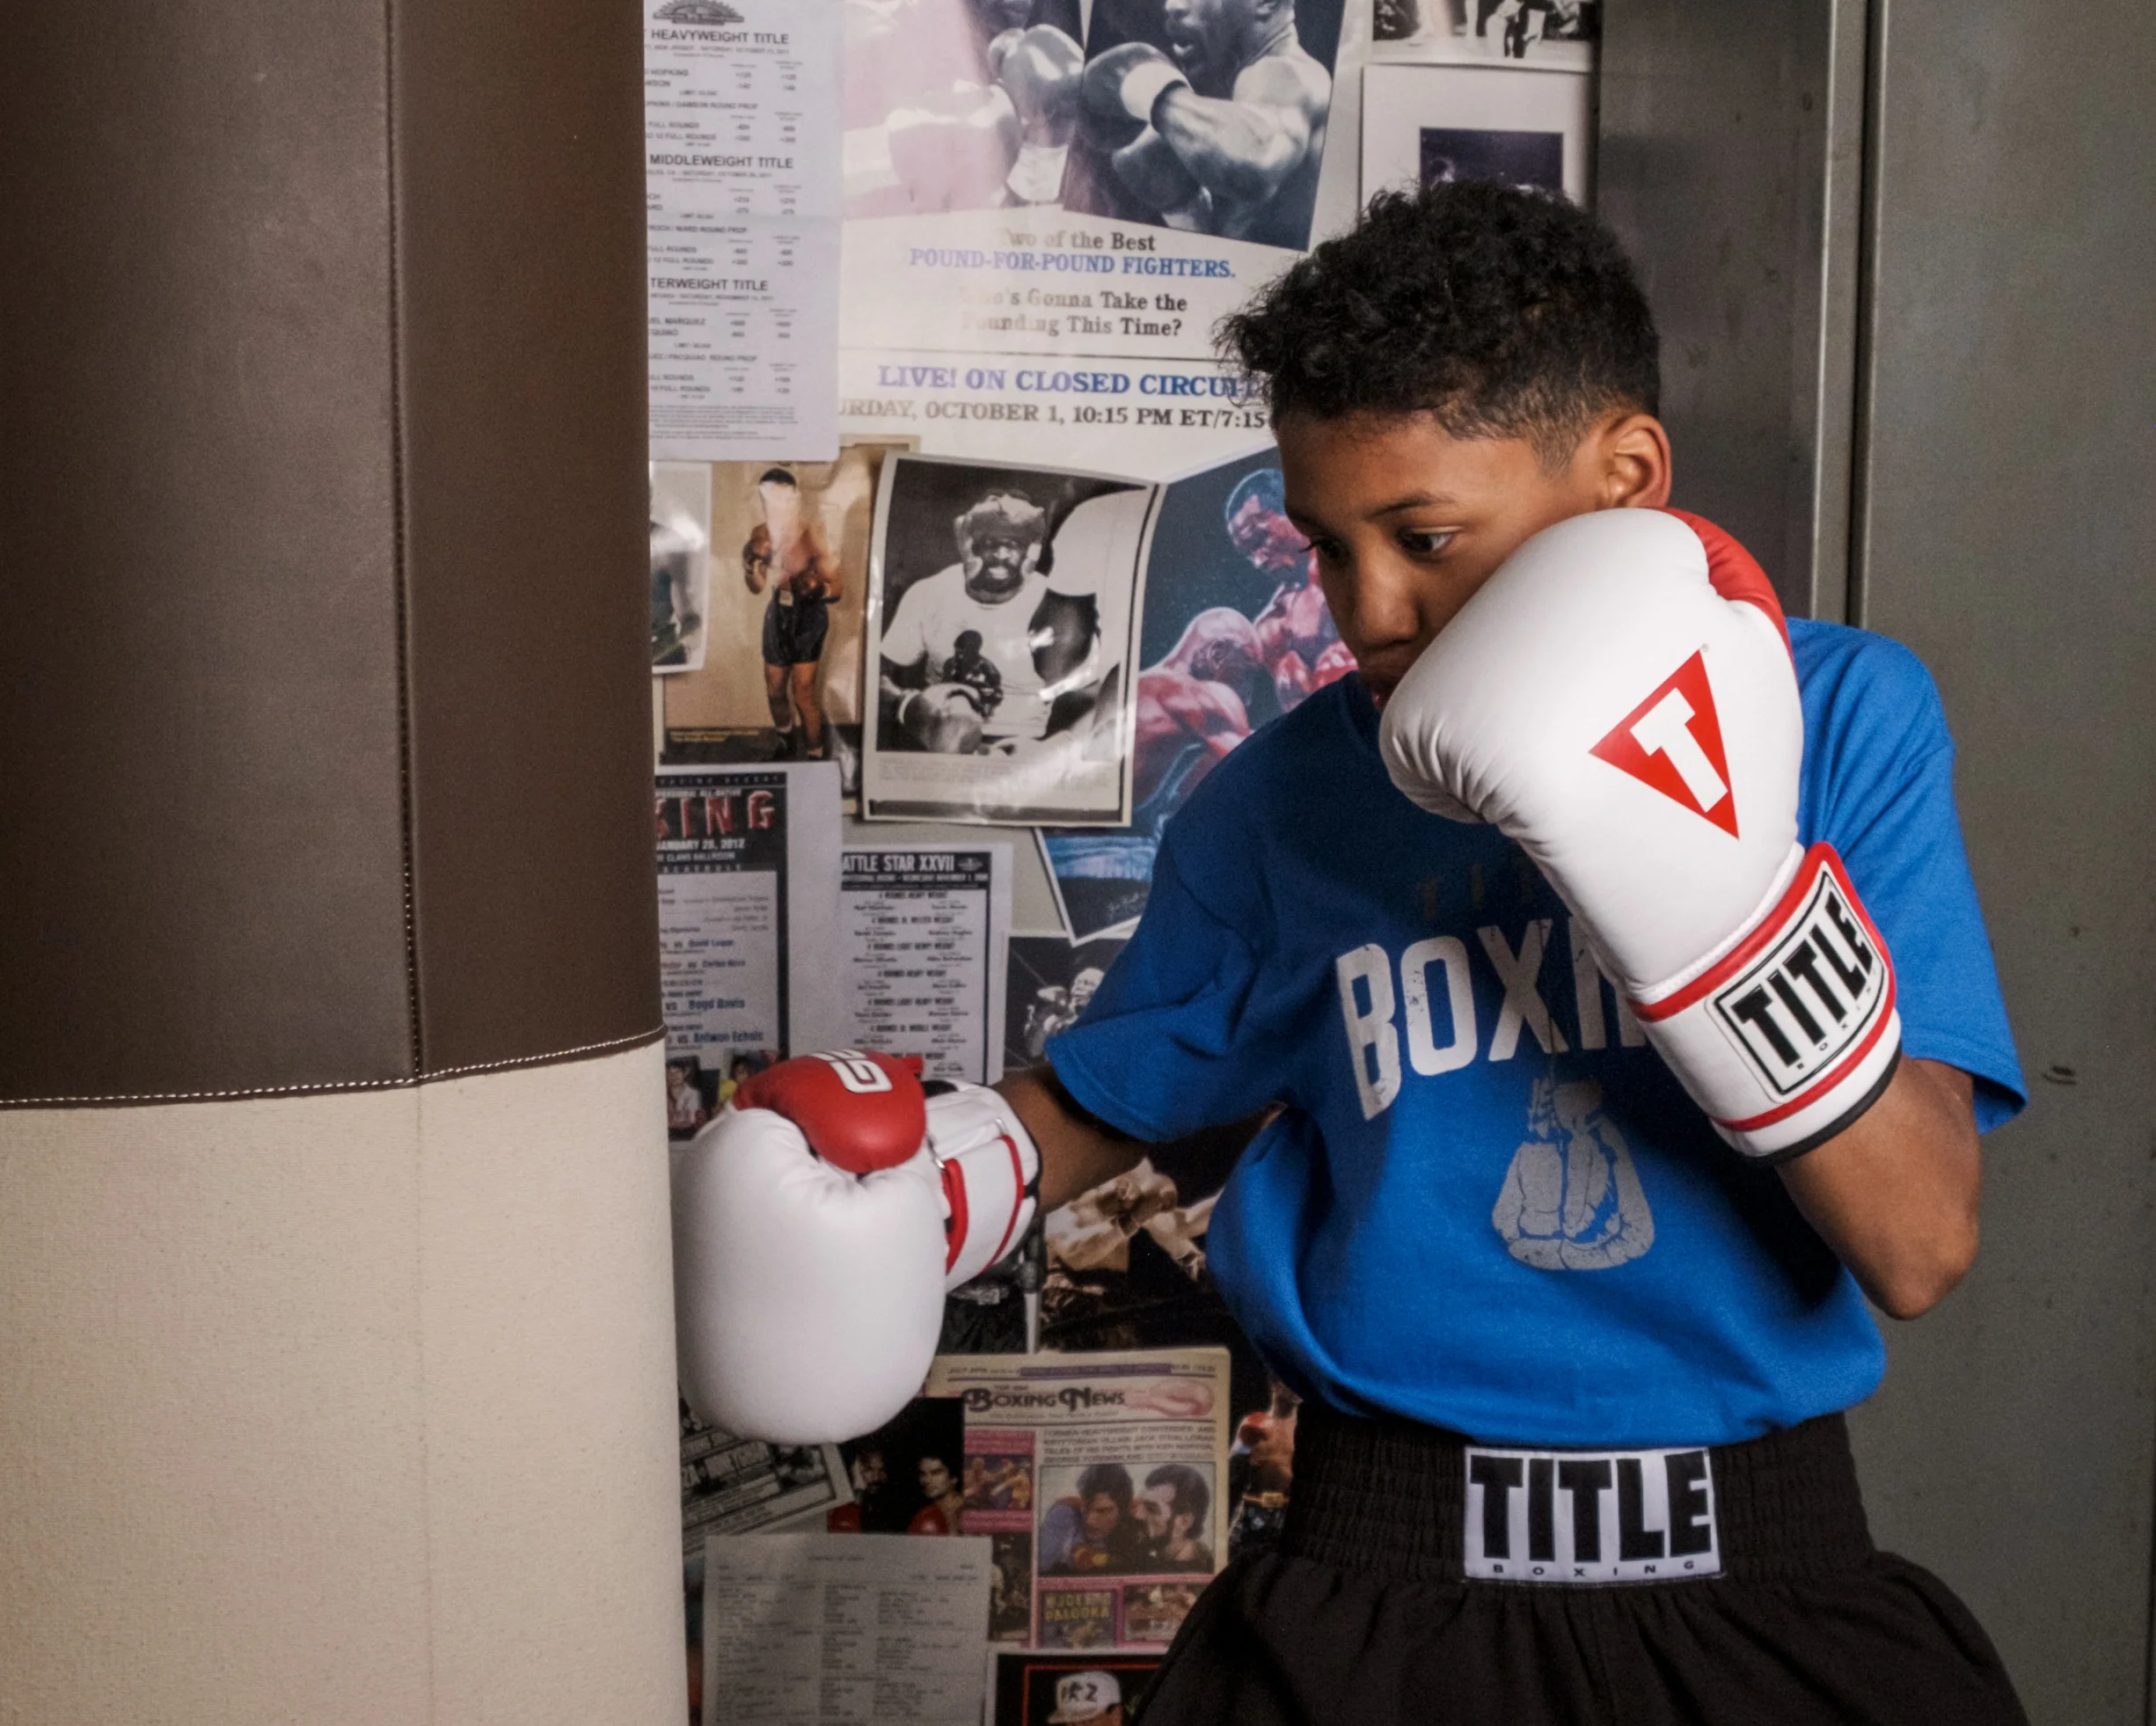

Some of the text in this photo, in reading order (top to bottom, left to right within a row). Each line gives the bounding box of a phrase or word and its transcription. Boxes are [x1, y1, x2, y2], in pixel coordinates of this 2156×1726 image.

[651, 29, 789, 44] HEAVYWEIGHT TITLE
[649, 154, 793, 169] MIDDLEWEIGHT TITLE
[1002, 230, 1155, 252] wo of the Best
[910, 247, 1235, 279] POUND-FOR-POUND FIGHTERS.
[650, 277, 768, 291] TERWEIGHT TITLE
[959, 287, 1188, 312] o's Gonna Take the
[961, 312, 1182, 338] undng This Time?
[878, 365, 958, 388] LIVE!
[965, 369, 1005, 391] ON
[1015, 370, 1131, 394] CLOSED
[925, 401, 1038, 422] OCTOBER
[1048, 405, 1064, 426] 1,
[1072, 405, 1128, 425] 10:15
[1136, 407, 1172, 427] PM
[1180, 408, 1266, 429] ET/7:15
[843, 854, 955, 872] ATTLE STAR XXVII
[1730, 890, 1874, 1068] TITLE
[1335, 915, 1647, 1122] BOXI
[961, 1386, 1125, 1413] BOXING NEWS
[1470, 1450, 1712, 1563] TITLE
[1493, 1560, 1695, 1577] BOXING
